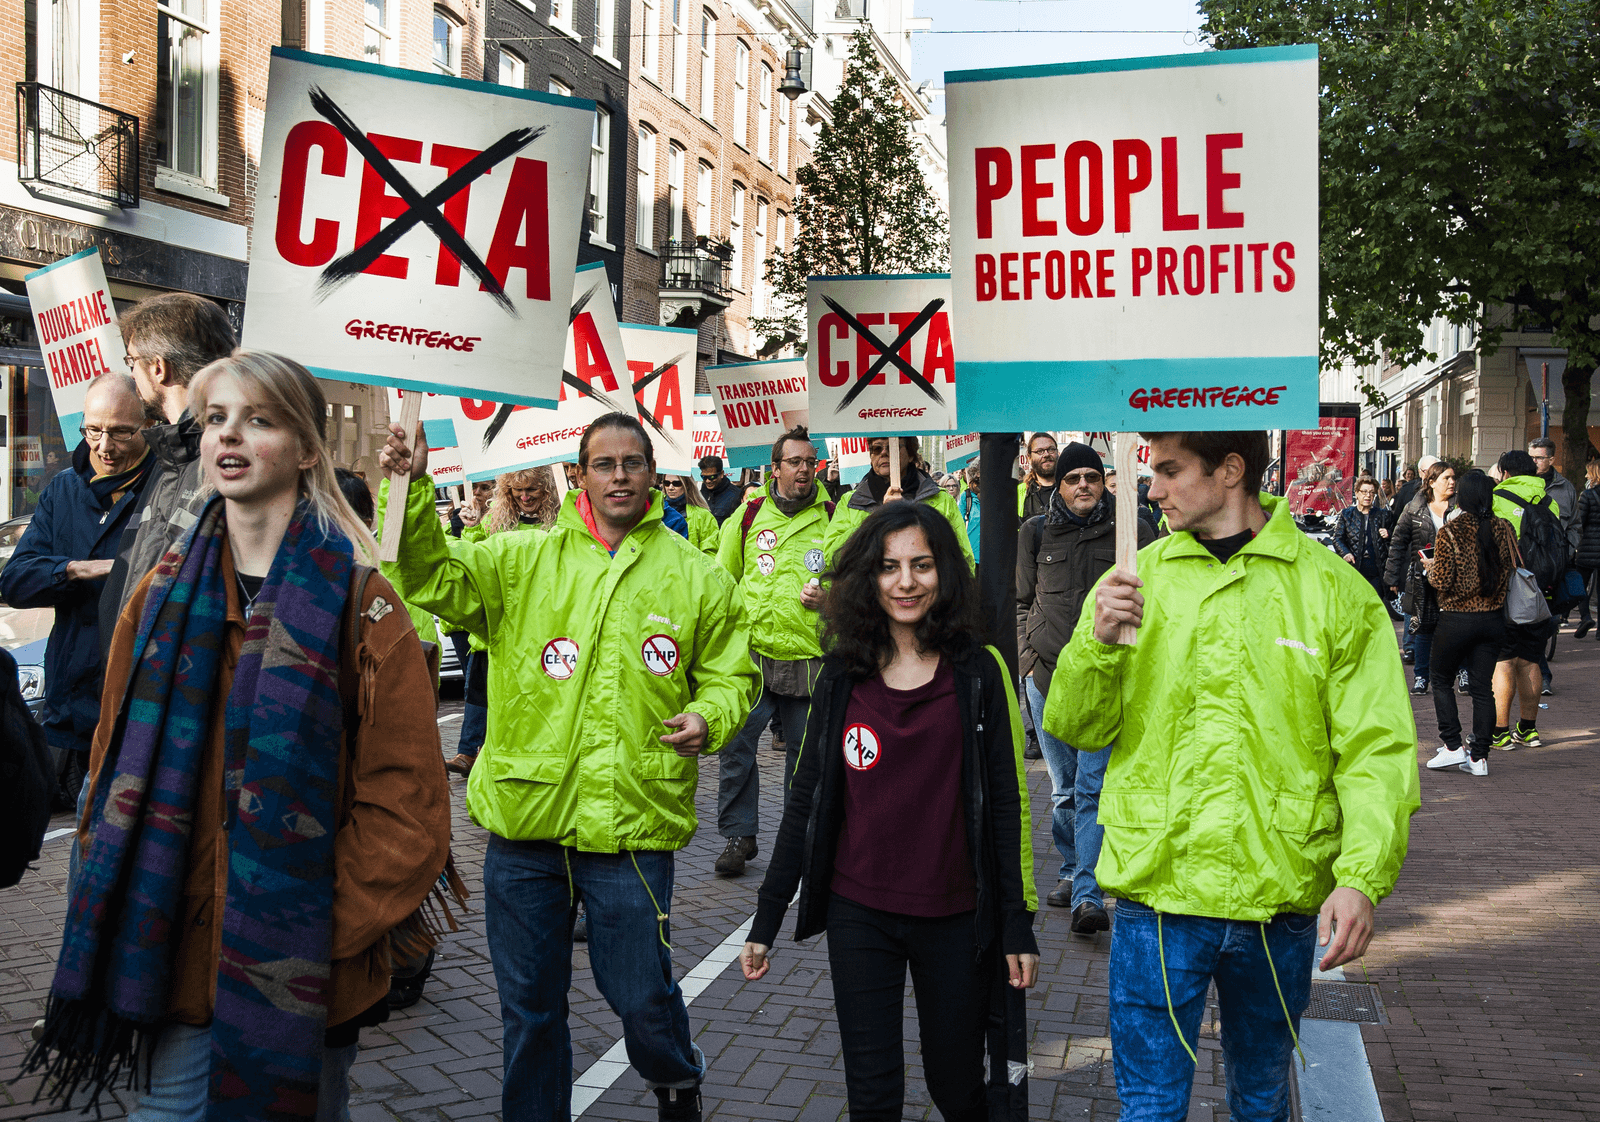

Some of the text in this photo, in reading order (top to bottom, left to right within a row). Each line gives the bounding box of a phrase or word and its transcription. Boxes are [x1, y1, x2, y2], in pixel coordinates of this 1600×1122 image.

[975, 132, 1245, 240] PEOPLE
[275, 119, 552, 301] CETA
[975, 240, 1296, 302] BEFORE PROFITS
[38, 289, 111, 345] DUURZAME
[345, 319, 482, 352] GREENPEACE
[47, 337, 111, 389] HANDEL
[818, 311, 956, 388] CETA
[716, 376, 807, 400] TRANSPARANCY
[1129, 385, 1288, 412] GREENPEACE
[722, 399, 780, 429] NOW!
[858, 407, 927, 419] GREENPEACE
[545, 654, 577, 664] CETA
